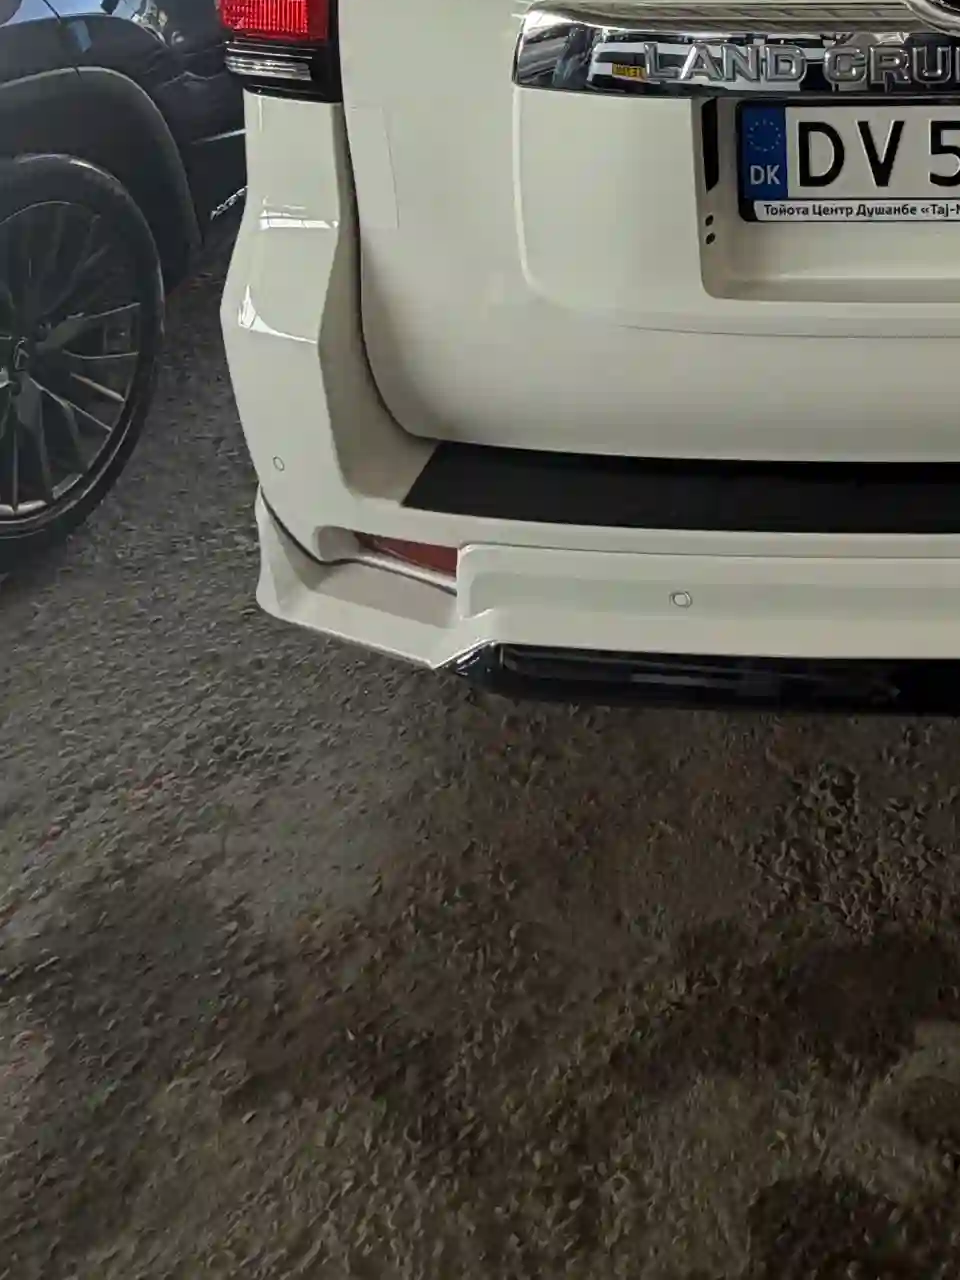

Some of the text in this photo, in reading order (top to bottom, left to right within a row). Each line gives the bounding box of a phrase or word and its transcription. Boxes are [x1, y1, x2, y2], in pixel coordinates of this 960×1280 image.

[644, 41, 806, 82] LAND
[797, 120, 906, 188] DV
[749, 165, 781, 186] DK
[764, 204, 809, 216] Тойота
[812, 204, 853, 218] Центр
[855, 204, 917, 217] Душанбе
